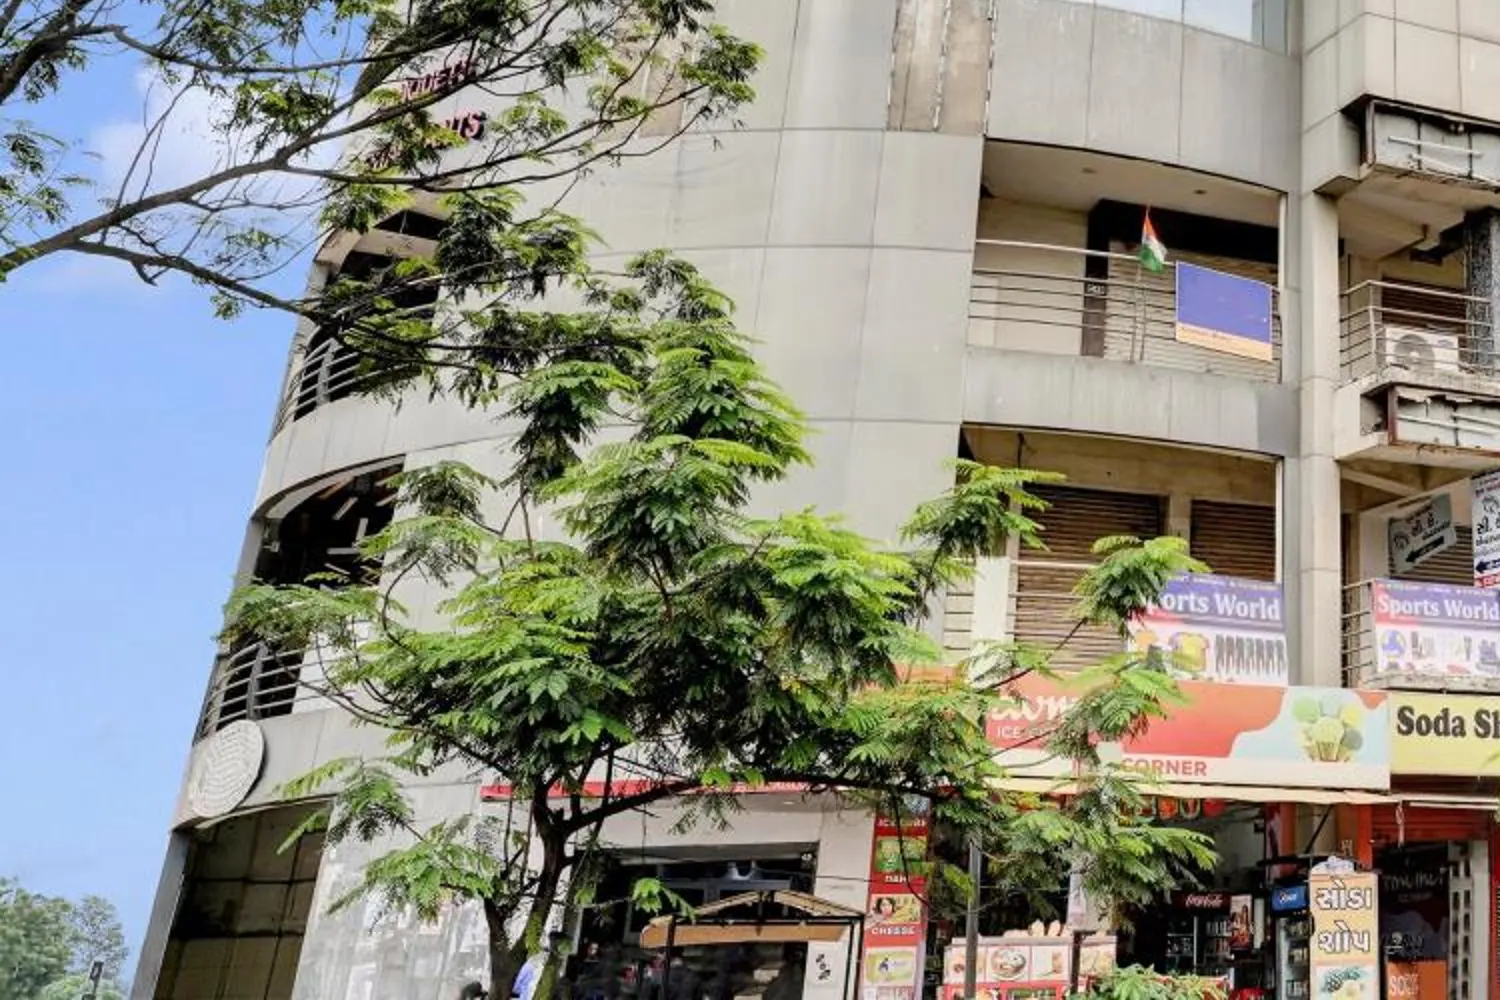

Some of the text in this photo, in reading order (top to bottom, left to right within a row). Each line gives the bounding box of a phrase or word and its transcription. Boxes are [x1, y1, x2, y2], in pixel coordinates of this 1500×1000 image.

[1147, 590, 1281, 621] ports World
[1378, 595, 1500, 621] Sports World
[1397, 706, 1466, 737] Soda
[1121, 757, 1208, 777] CORNER
[1315, 879, 1373, 911] સોડા
[1315, 919, 1372, 954] શોપ
